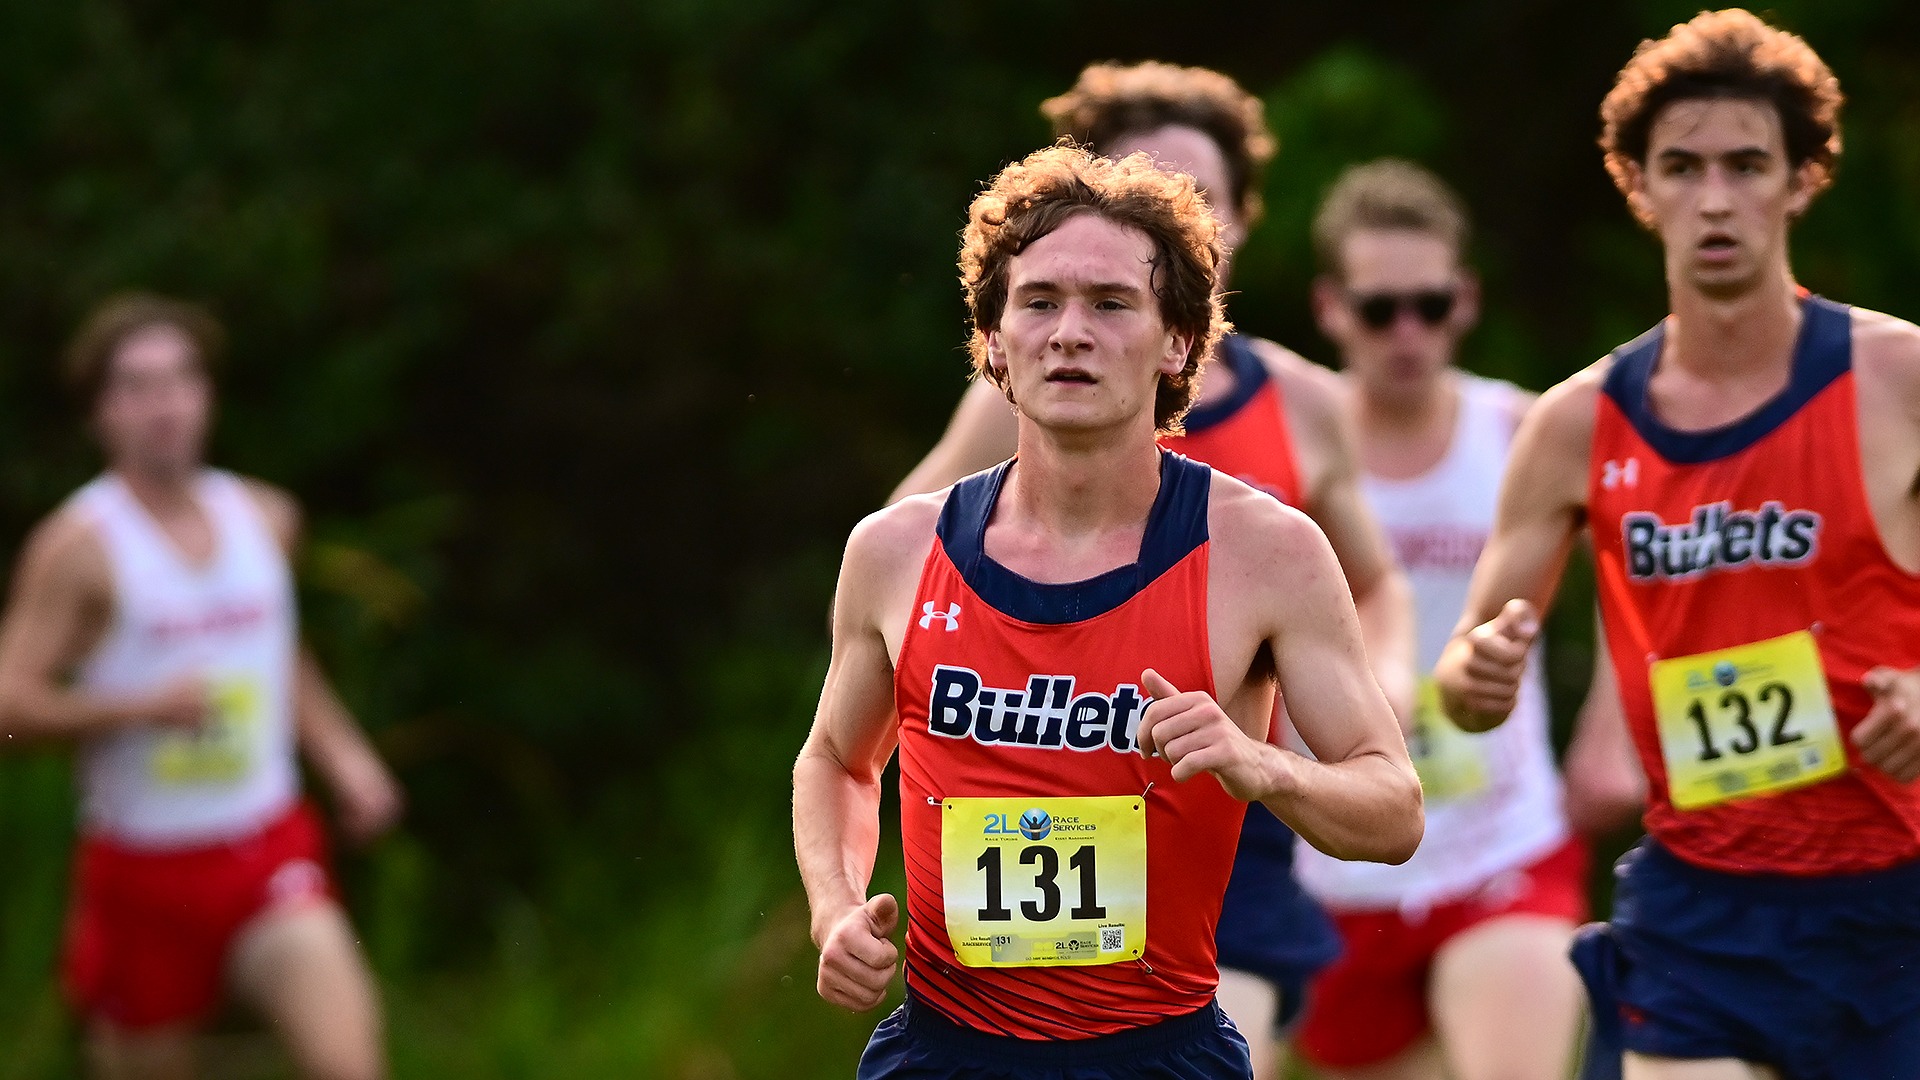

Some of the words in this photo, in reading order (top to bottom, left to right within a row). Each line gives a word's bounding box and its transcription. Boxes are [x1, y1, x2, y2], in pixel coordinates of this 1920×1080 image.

[1621, 500, 1821, 584] Bullets
[1687, 681, 1806, 762] 132
[983, 813, 1019, 834] 2L
[977, 845, 1107, 921] 131
[996, 936, 1011, 945] 131
